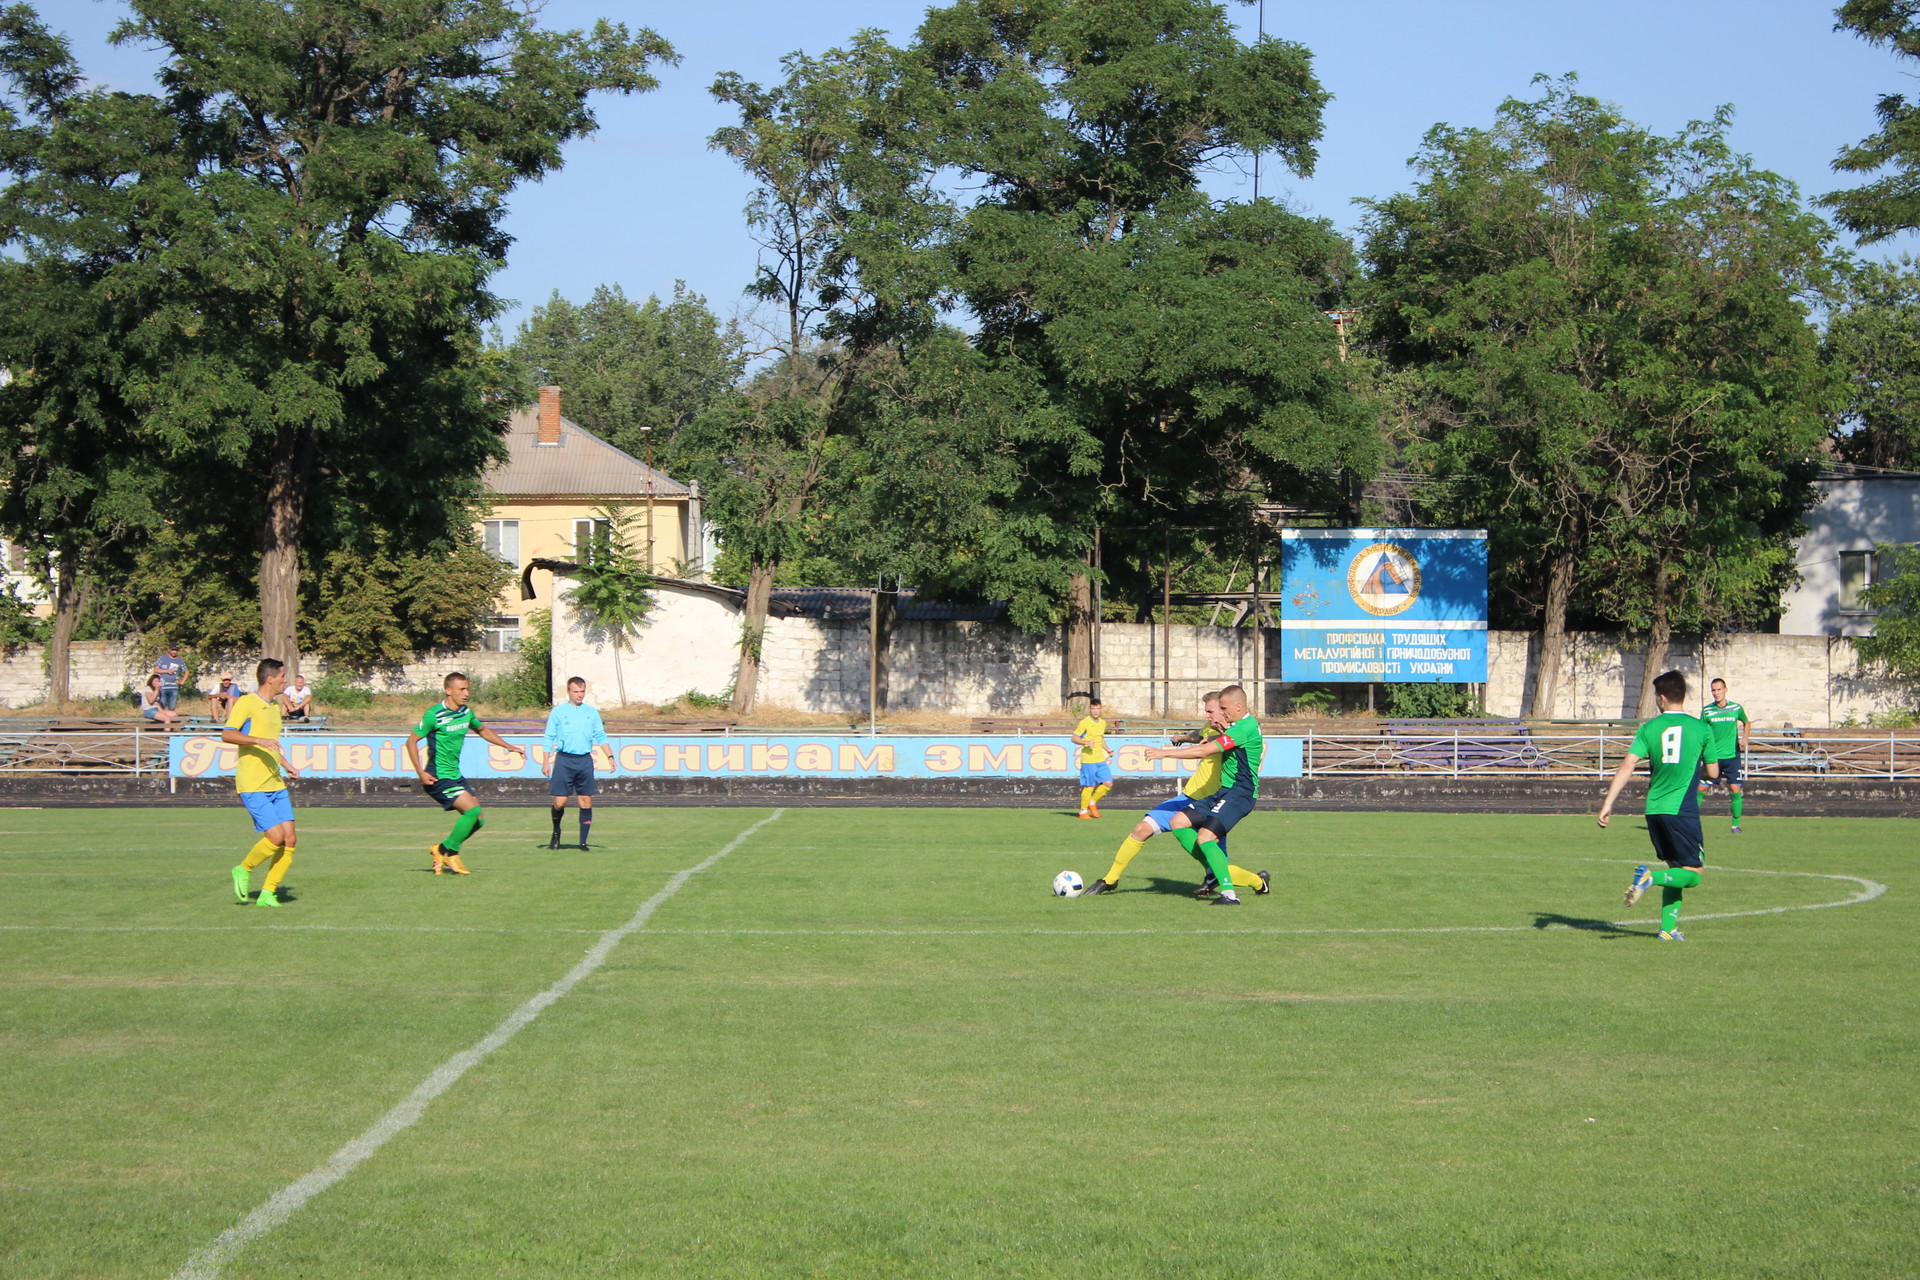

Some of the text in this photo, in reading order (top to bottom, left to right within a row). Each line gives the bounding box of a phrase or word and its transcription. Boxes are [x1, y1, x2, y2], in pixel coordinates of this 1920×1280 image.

[1392, 633, 1446, 645] ТРУДЯЩИХ
[1410, 662, 1453, 674] УКРАЇНИ
[1662, 726, 1682, 764] 8
